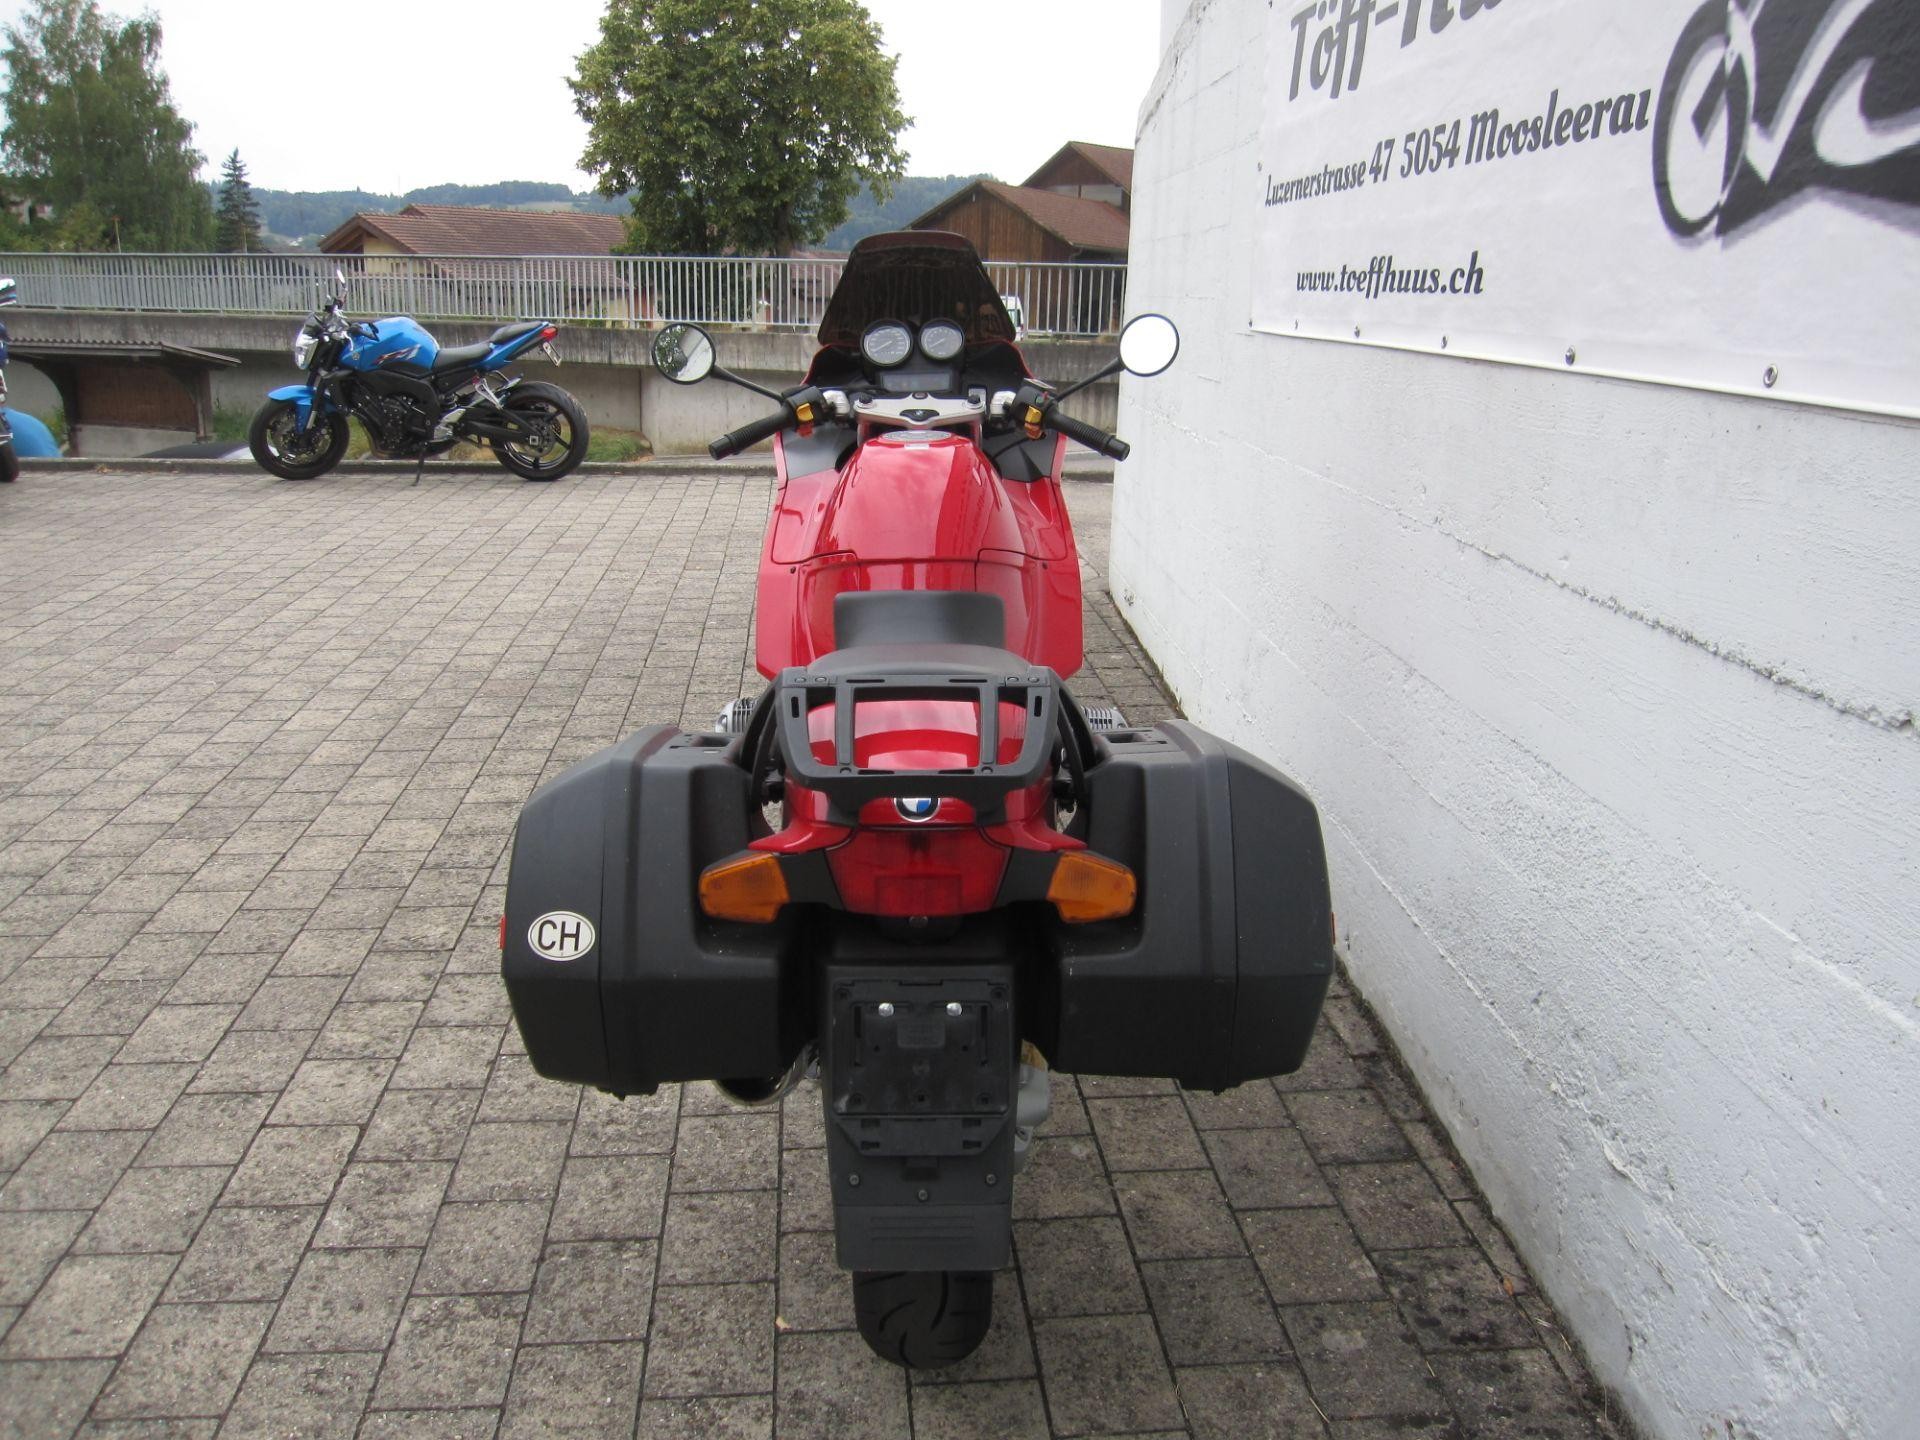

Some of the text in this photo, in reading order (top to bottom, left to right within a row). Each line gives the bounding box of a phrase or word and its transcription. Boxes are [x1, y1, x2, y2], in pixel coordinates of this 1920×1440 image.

[1265, 160, 1366, 207] Luzernerstrasse
[1369, 138, 1395, 184] 47
[1400, 119, 1460, 179] 5054
[1296, 250, 1484, 299] www.toeffhuus.ch
[538, 919, 581, 951] CH
